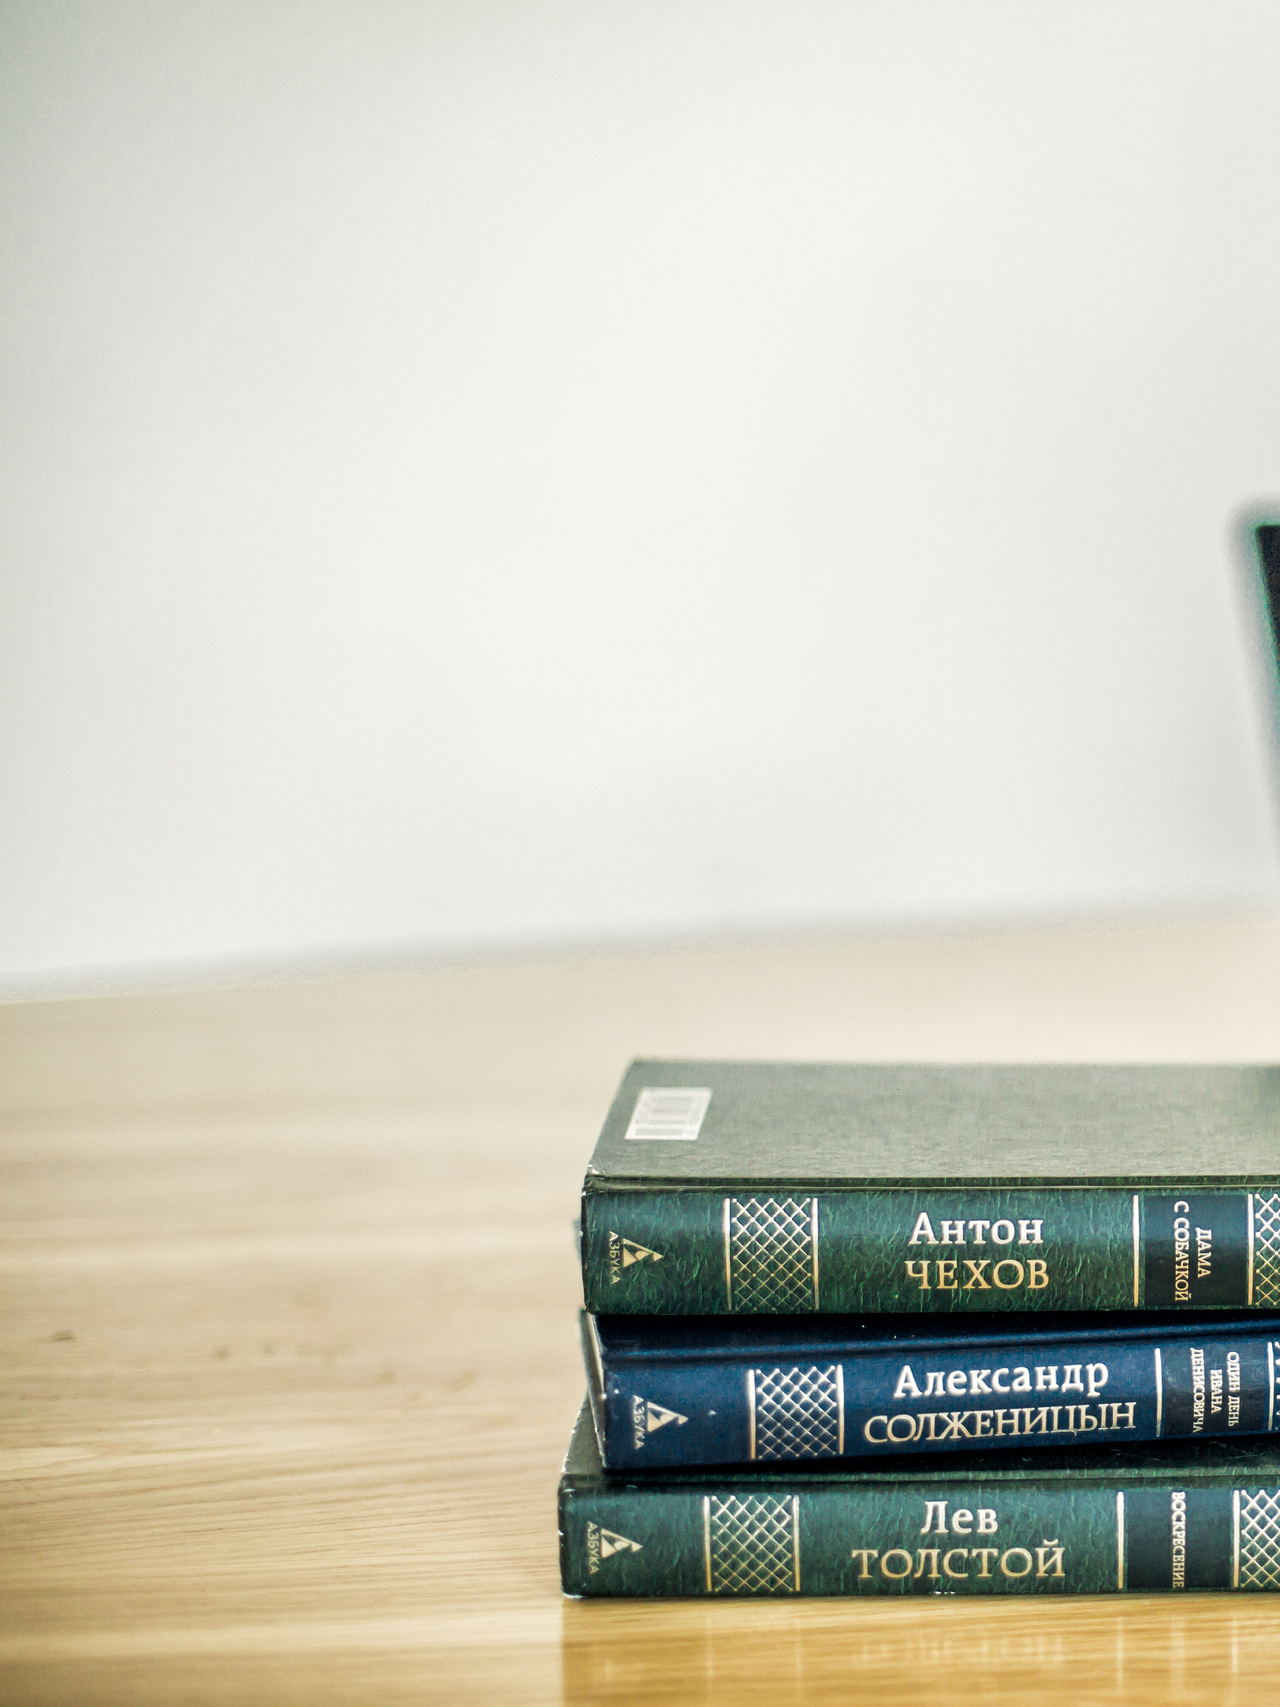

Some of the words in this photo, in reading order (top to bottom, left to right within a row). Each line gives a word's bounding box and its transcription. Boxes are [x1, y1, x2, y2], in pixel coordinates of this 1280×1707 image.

[1173, 1200, 1190, 1213] С
[908, 1211, 1044, 1245] Антон
[609, 1230, 620, 1285] АЗБУКА
[1173, 1217, 1192, 1302] СОБАЧКОЙ
[1195, 1227, 1212, 1278] ДАМА
[904, 1259, 1050, 1290] ЧЕХОВ
[893, 1362, 1109, 1398] Александр
[1190, 1347, 1206, 1434] ДЕНИСОВИЧА
[1210, 1368, 1223, 1414] ИВАНА
[1226, 1351, 1241, 1392] ОДИН
[864, 1401, 1137, 1443] СОЛЖЕНИЦЫН
[1227, 1395, 1241, 1427] ДЕНЬ
[920, 1500, 998, 1534] Лев
[587, 1520, 600, 1575] АЗБУКА
[851, 1538, 1066, 1578] ТОЛСТОЙ
[1170, 1491, 1187, 1588] ВОСКРЕСЕНИЕ
